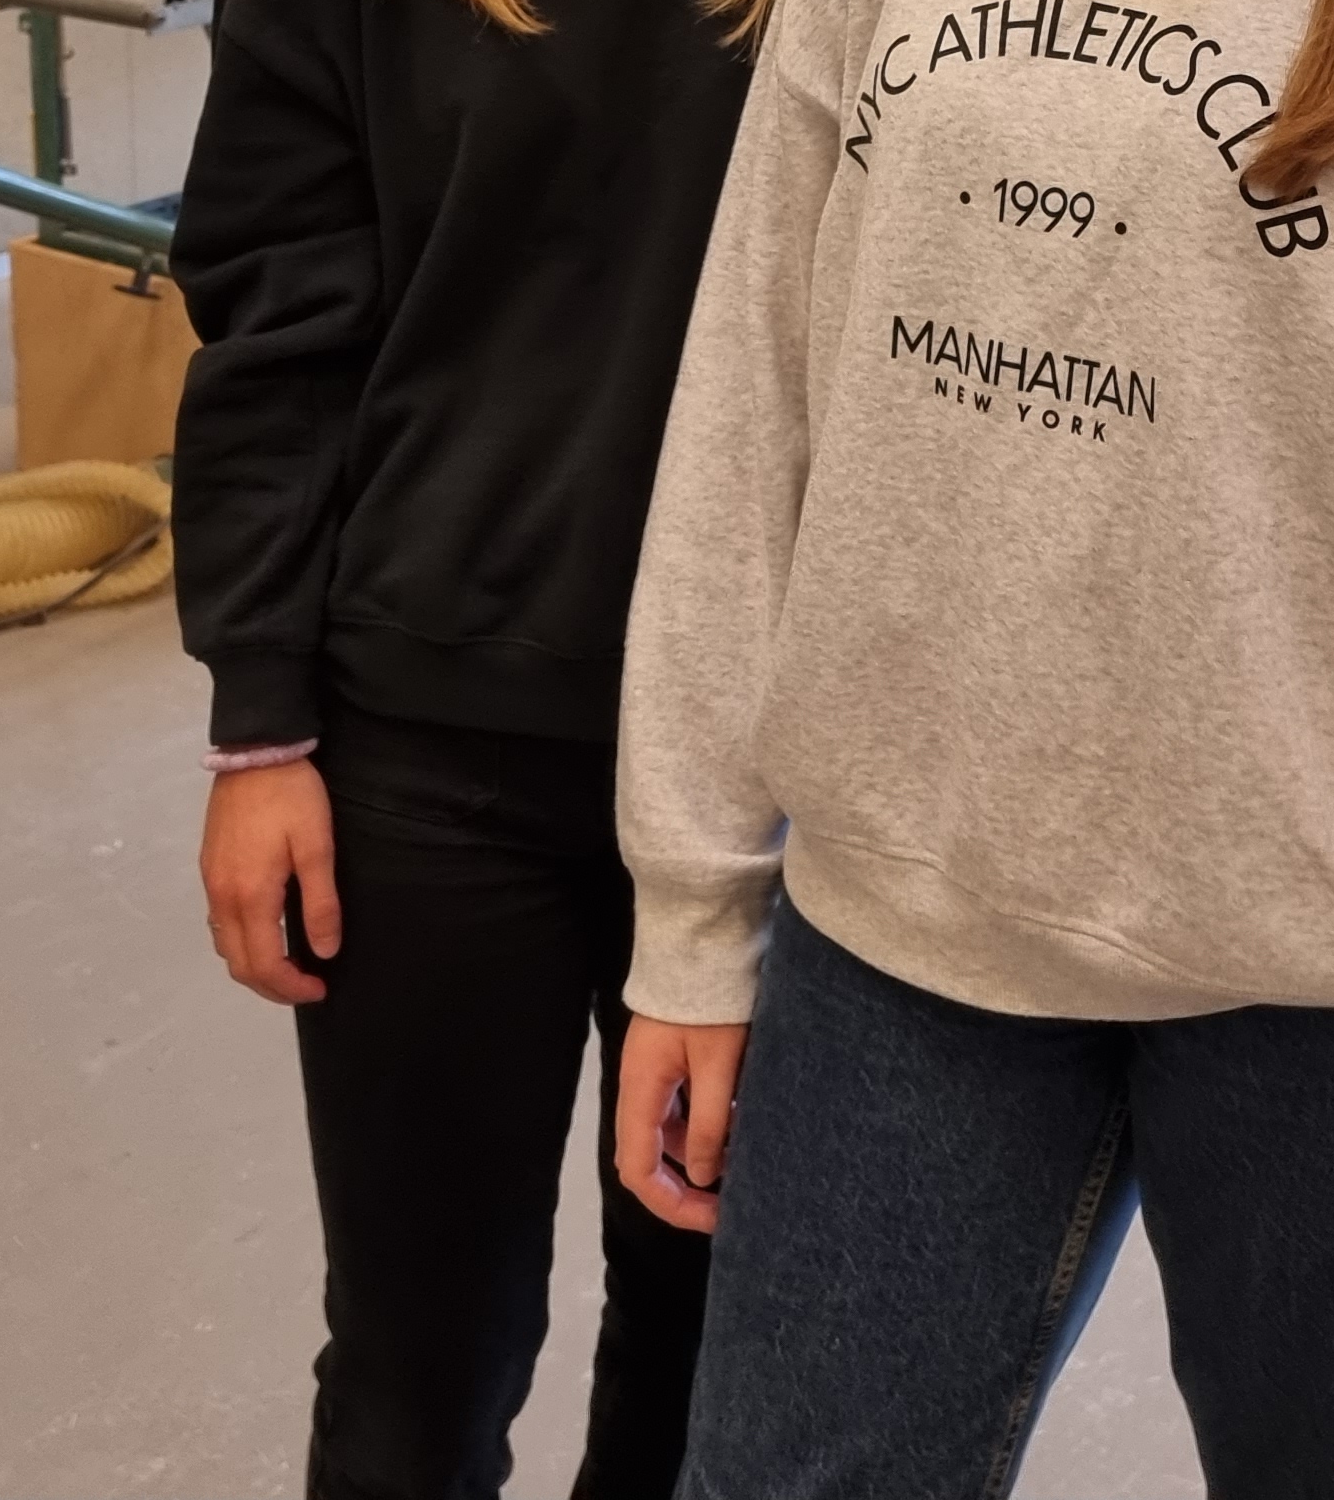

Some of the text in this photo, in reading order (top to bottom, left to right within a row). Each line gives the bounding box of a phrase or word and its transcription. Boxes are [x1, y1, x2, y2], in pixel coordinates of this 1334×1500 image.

[845, 33, 918, 175] NYC
[993, 178, 1096, 239] 1999
[890, 314, 1156, 424] MANHATTAN
[934, 376, 1107, 443] NEW YORK
